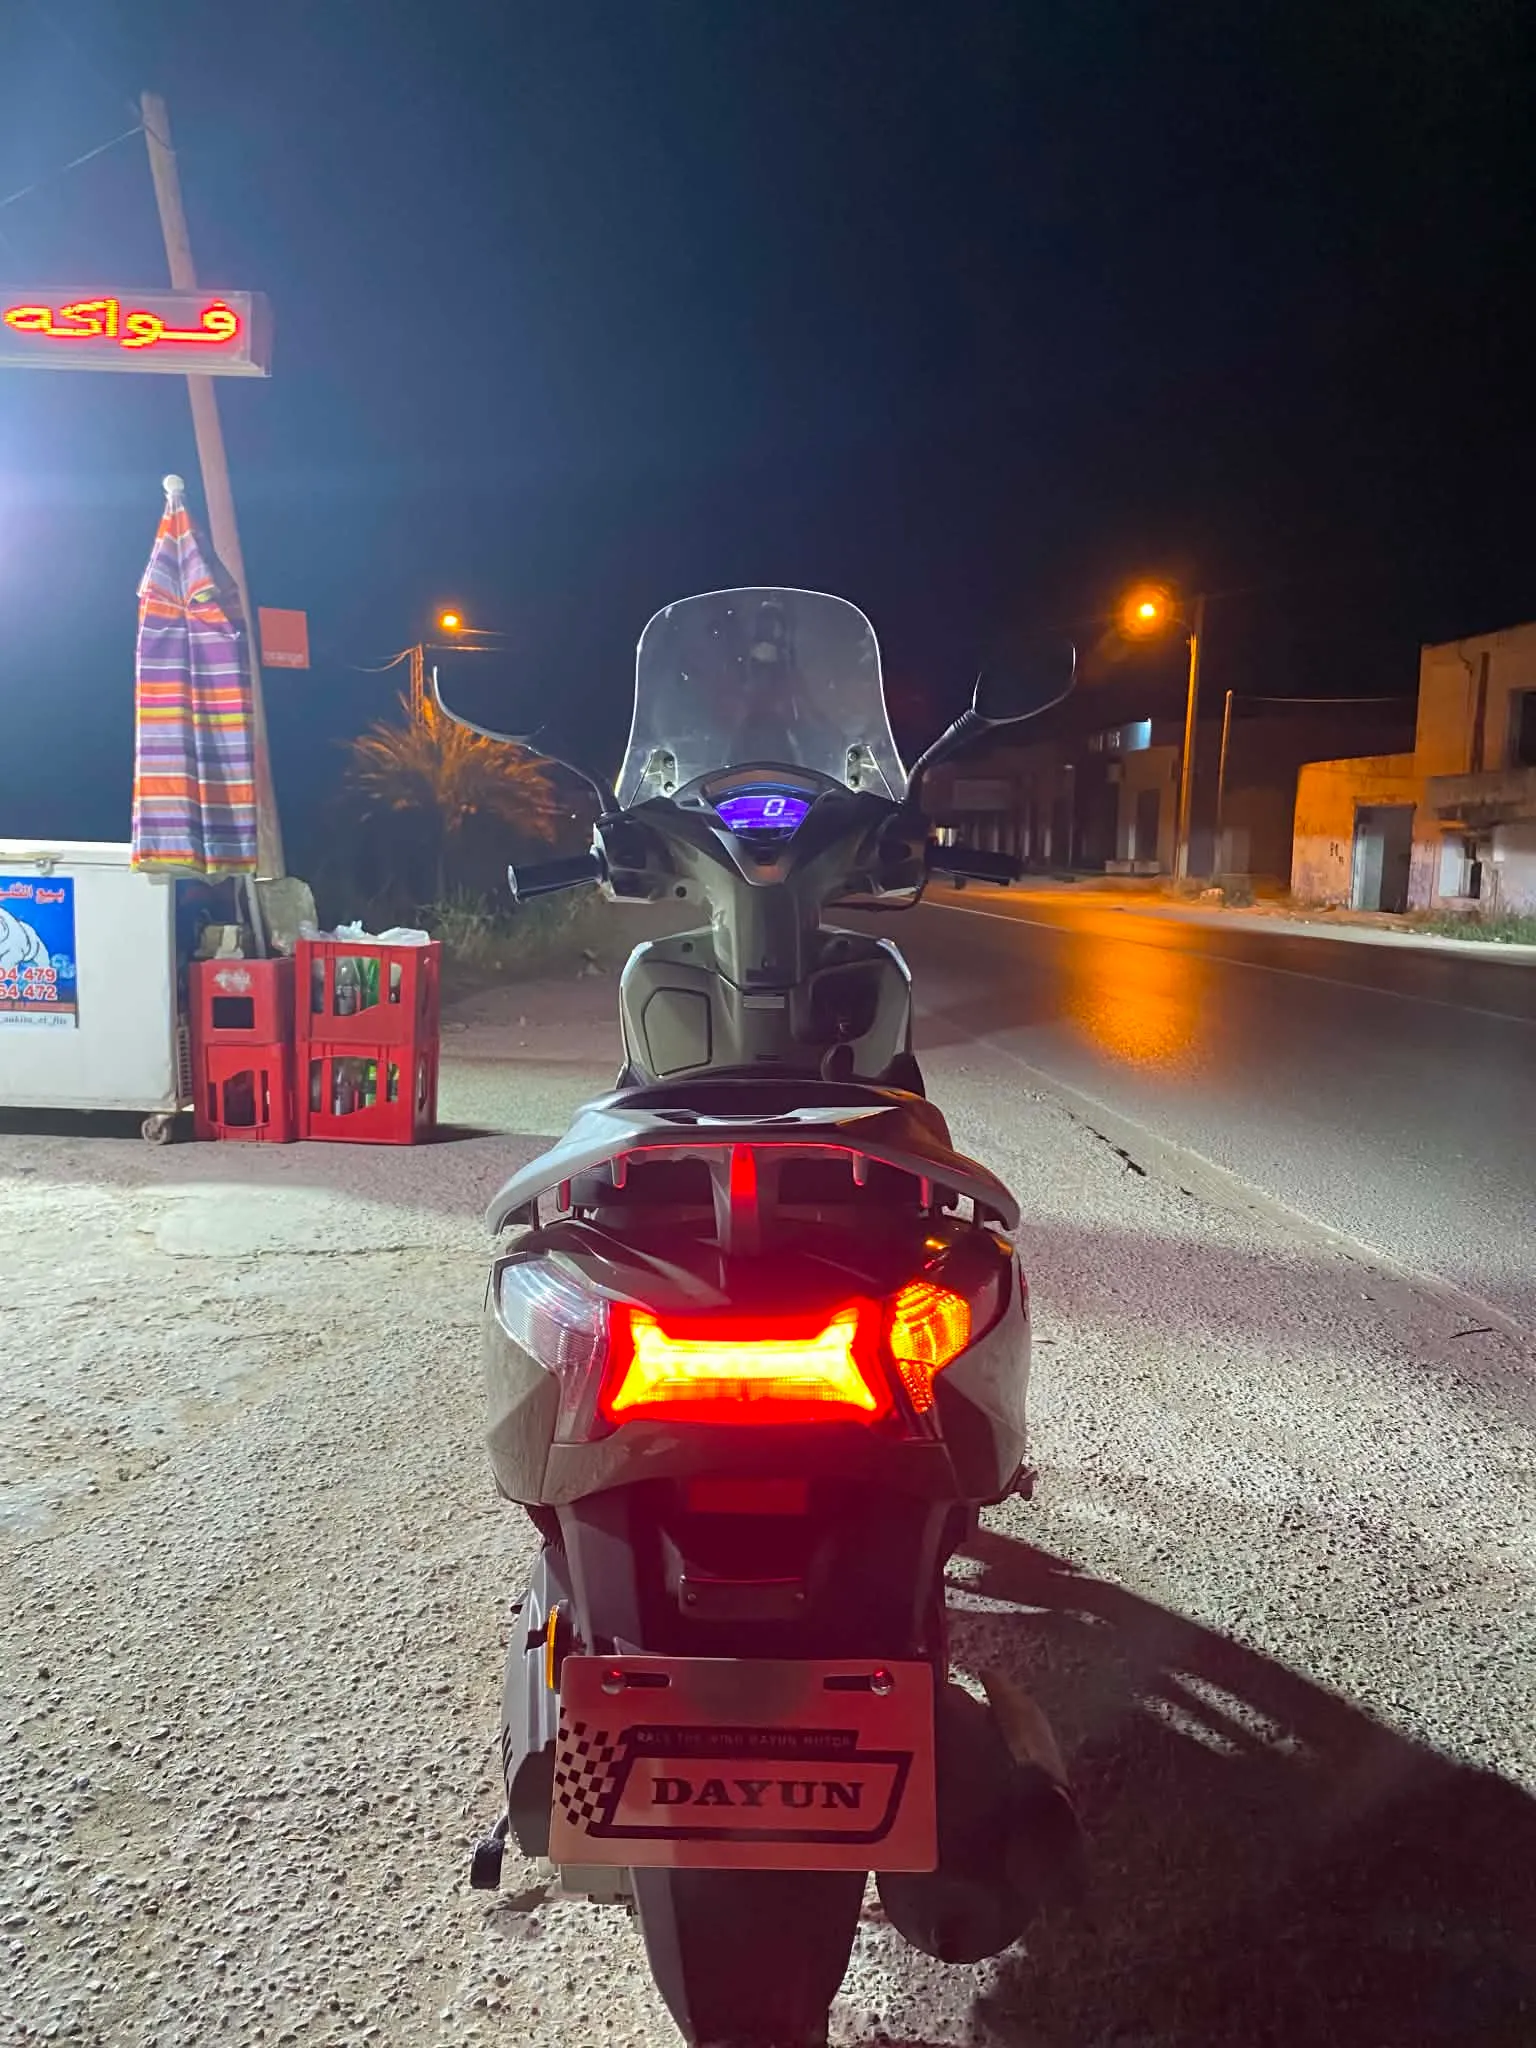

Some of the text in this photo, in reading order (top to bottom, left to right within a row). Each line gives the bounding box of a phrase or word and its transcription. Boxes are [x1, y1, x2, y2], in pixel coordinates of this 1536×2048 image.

[763, 798, 786, 816] 0
[24, 967, 55, 982] 479
[24, 984, 56, 998] 472
[651, 1777, 864, 1809] DAYUN
